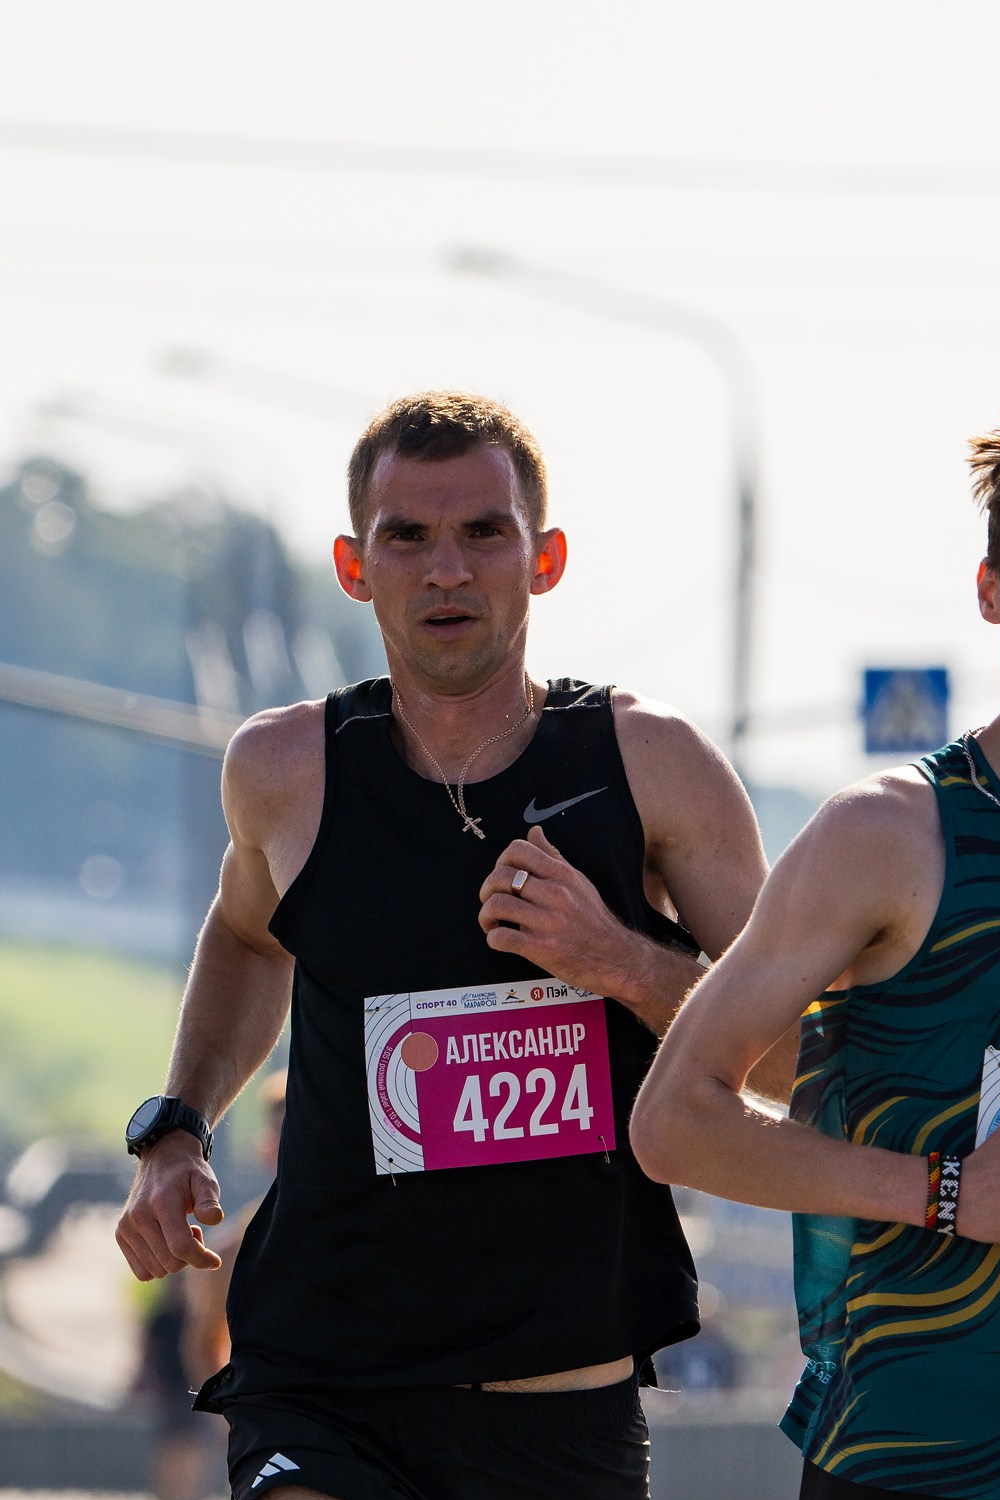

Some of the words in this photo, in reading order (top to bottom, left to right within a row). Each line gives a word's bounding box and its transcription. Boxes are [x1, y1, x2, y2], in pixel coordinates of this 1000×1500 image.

[547, 985, 568, 998] Пэй
[416, 1002, 444, 1010] СПОРТ
[446, 1000, 457, 1008] 40
[464, 1000, 497, 1009] МАРАФОН
[445, 1023, 587, 1065] АЛЕКСАНДР
[453, 1063, 594, 1142] 4224
